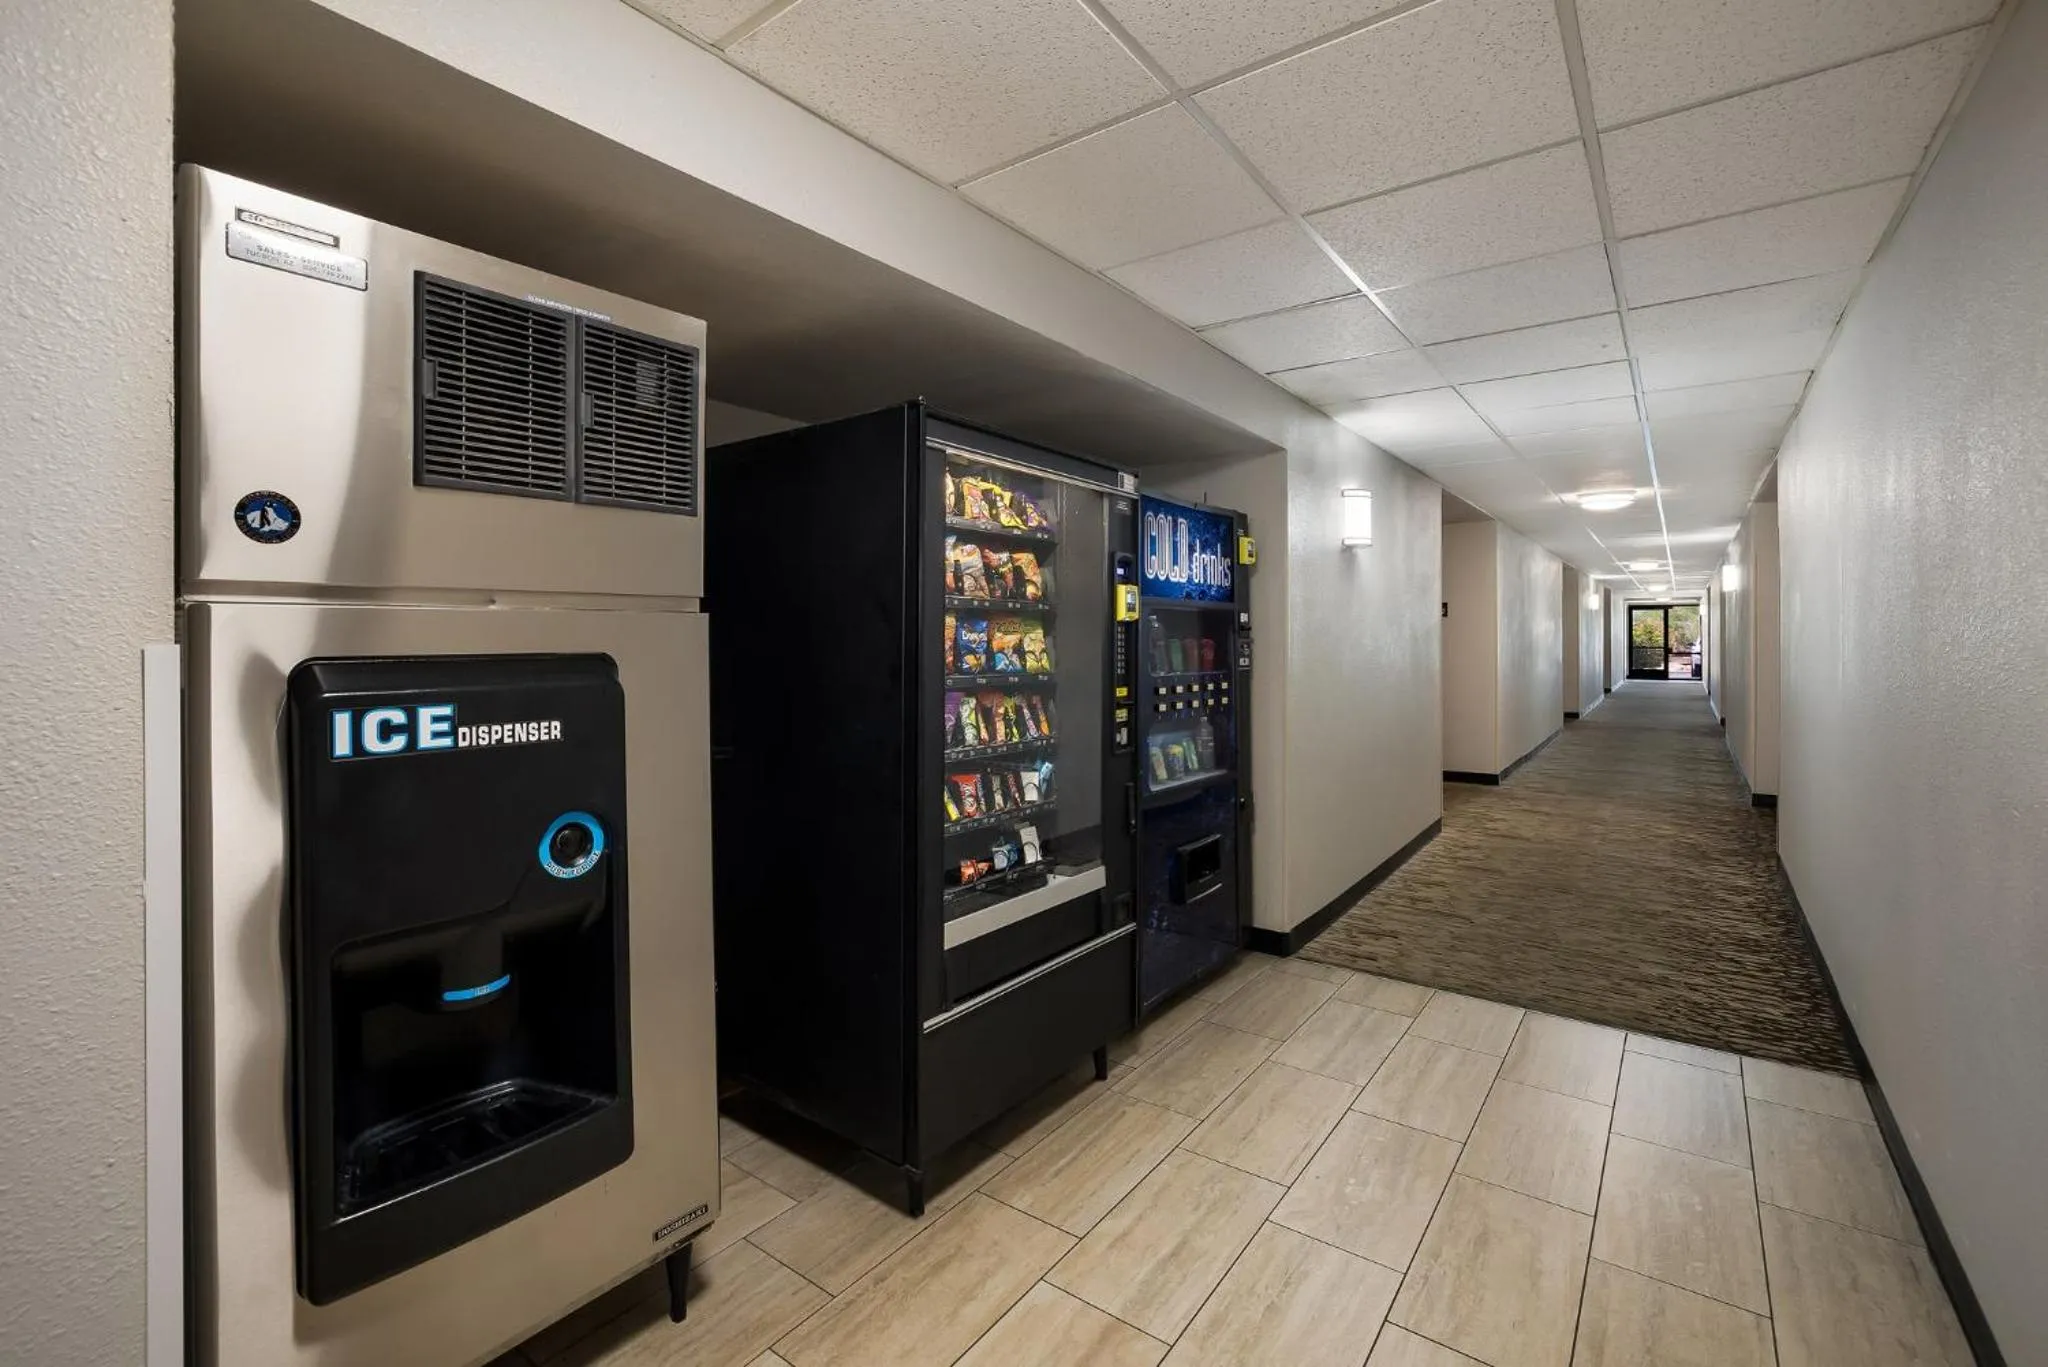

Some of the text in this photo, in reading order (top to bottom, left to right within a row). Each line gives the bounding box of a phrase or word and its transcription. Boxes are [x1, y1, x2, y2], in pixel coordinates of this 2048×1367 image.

[1144, 511, 1231, 588] COLD drinks
[332, 704, 561, 758] ICE DISPENSER
